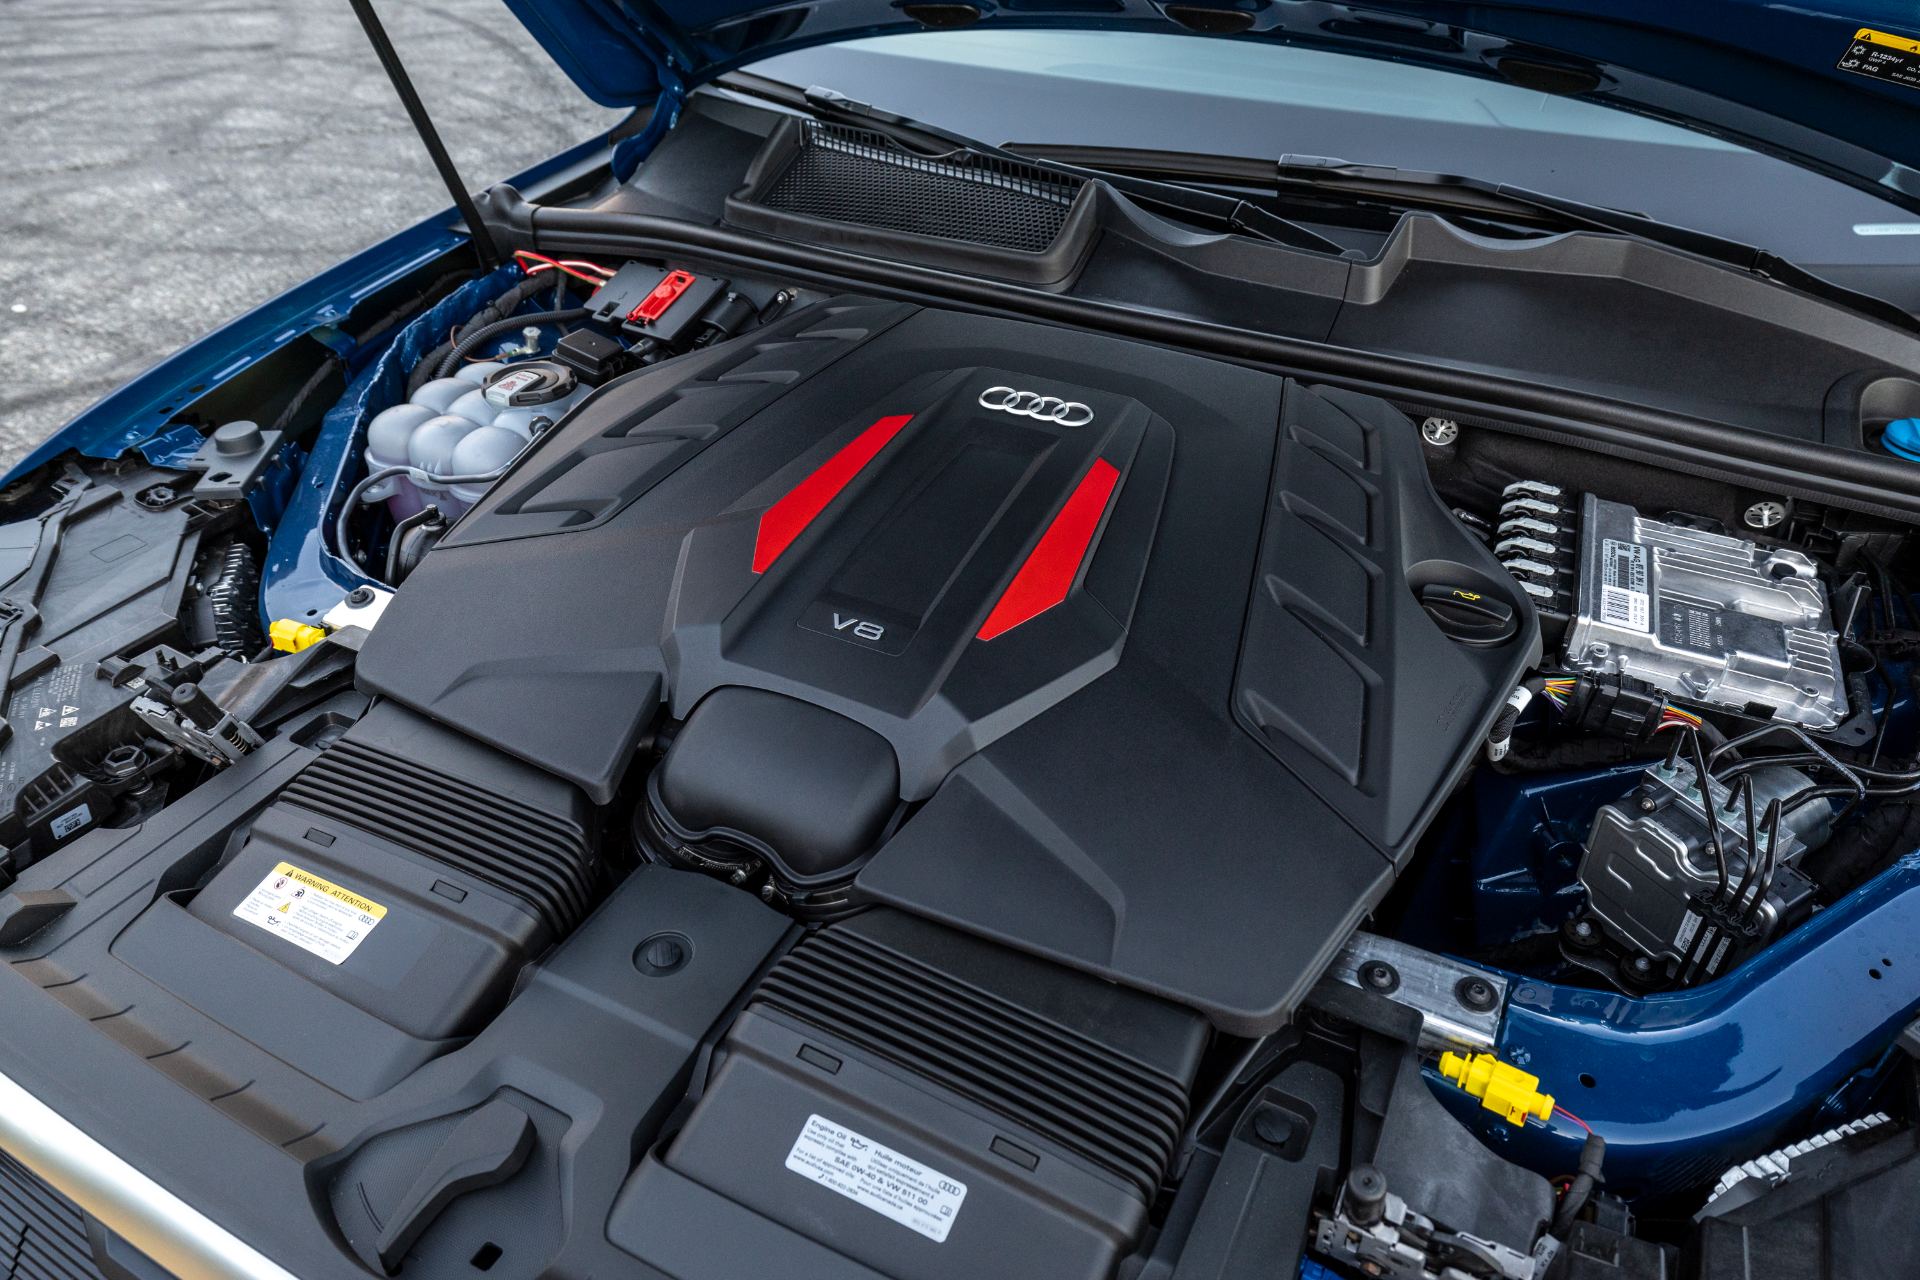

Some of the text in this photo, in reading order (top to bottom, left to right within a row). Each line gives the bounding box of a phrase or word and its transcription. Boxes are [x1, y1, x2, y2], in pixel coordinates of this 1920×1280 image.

[1862, 64, 1879, 72] PAG
[1871, 51, 1904, 64] R-1234yf
[833, 613, 885, 641] V8
[294, 873, 329, 892] WARNING
[331, 889, 373, 912] ATTENTION
[810, 1119, 847, 1140] Engine Oil
[873, 1149, 923, 1176] Huile moteur
[833, 1156, 850, 1168] SAE
[850, 1164, 876, 1180] 0W-40
[876, 1176, 884, 1184] &
[885, 1180, 900, 1192] VW
[916, 1195, 928, 1205] 00
